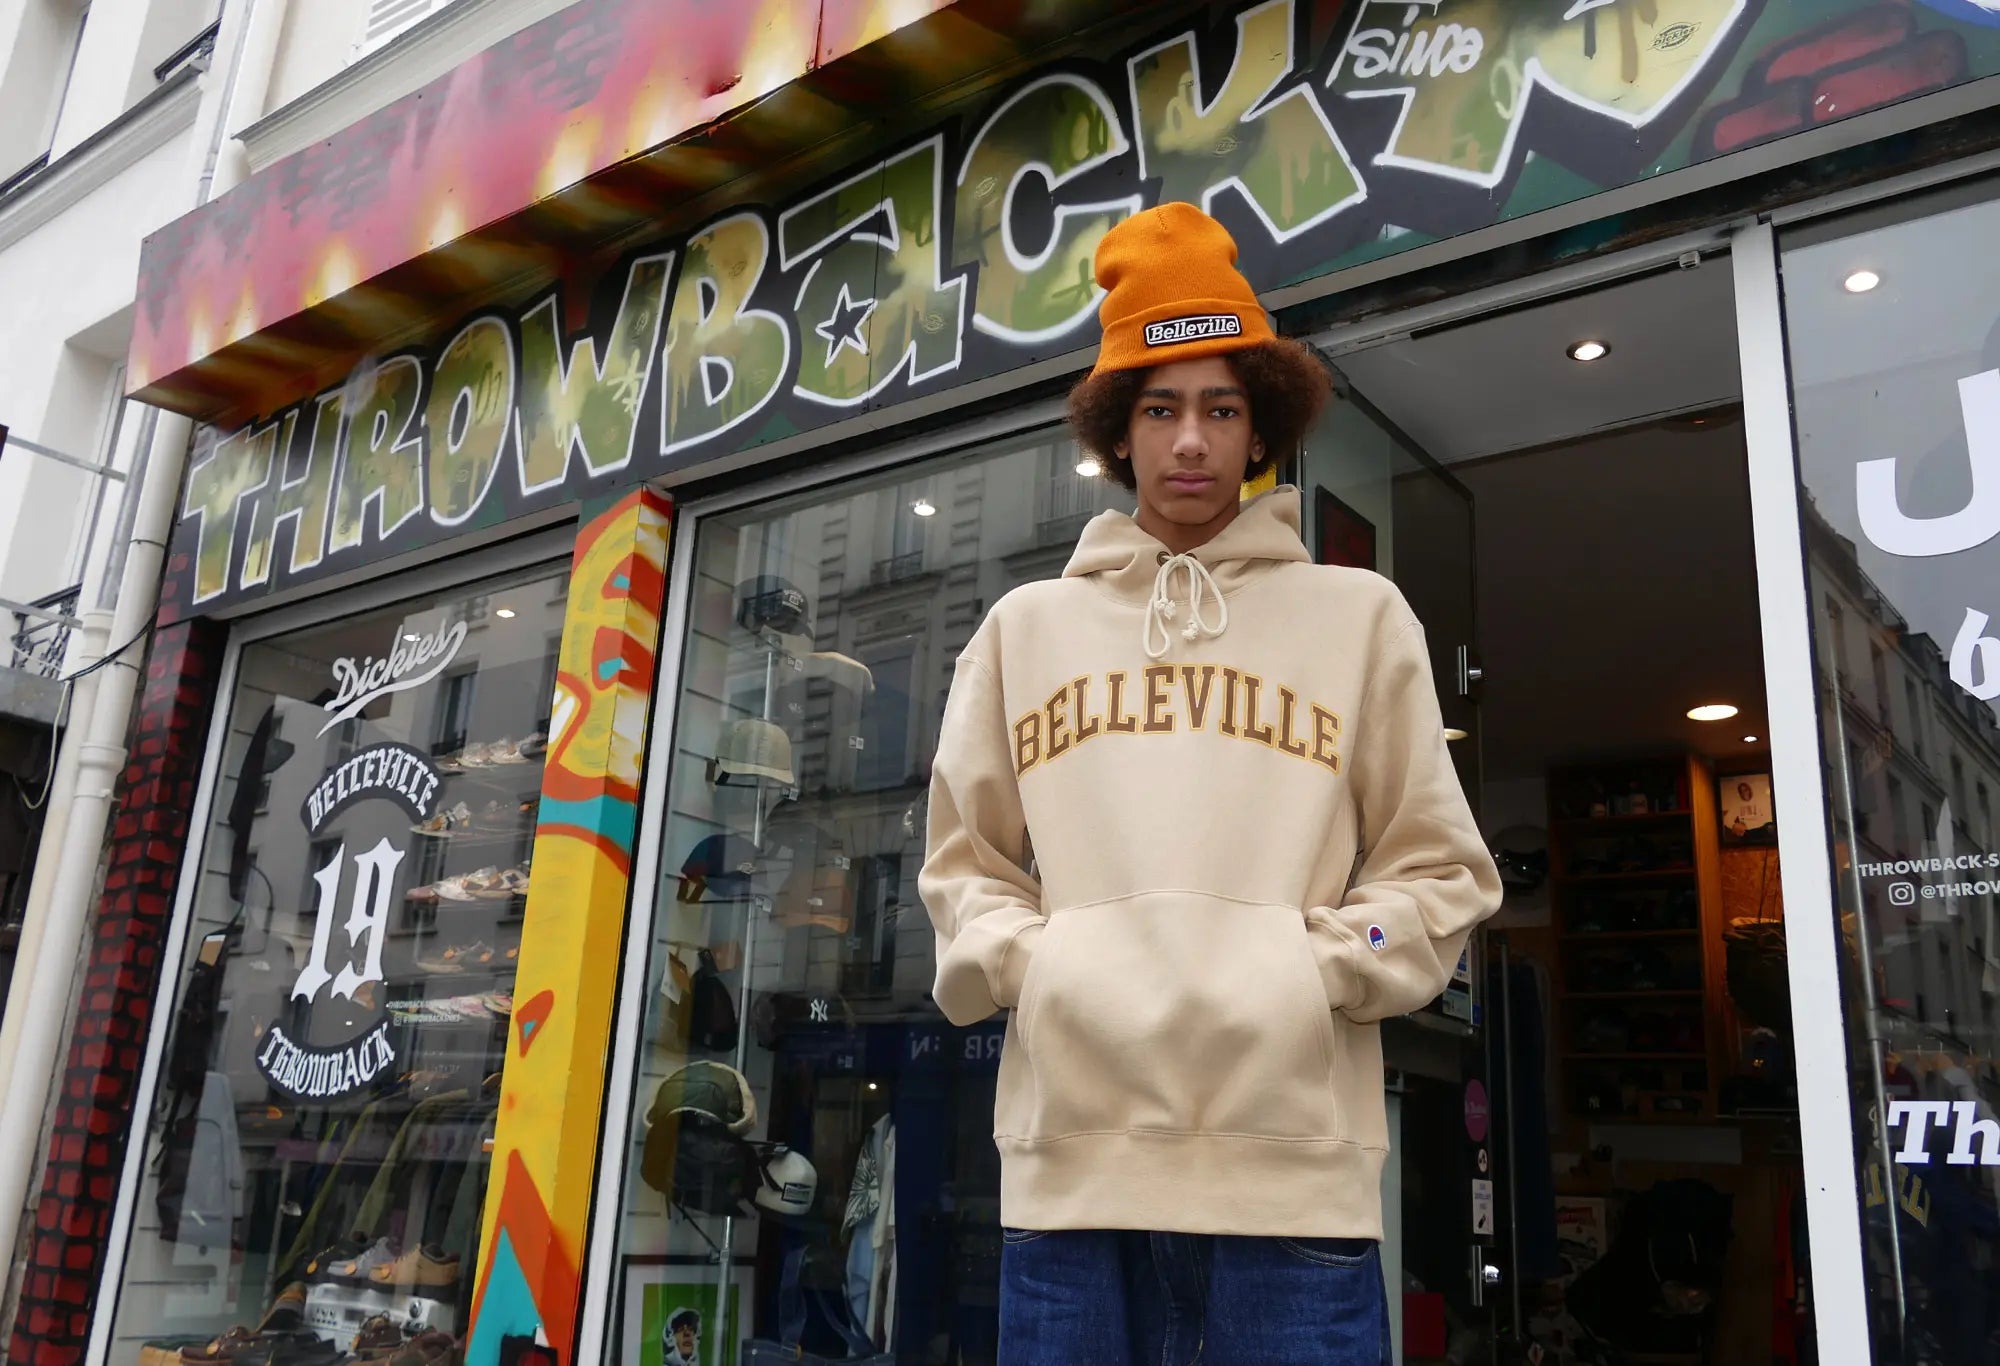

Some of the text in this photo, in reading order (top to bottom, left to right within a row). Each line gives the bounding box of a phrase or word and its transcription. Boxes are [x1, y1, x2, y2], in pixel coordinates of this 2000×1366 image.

[1149, 318, 1236, 342] Belleville
[322, 618, 467, 716] Dickies
[1013, 663, 1341, 780] BELLEVILLE
[307, 746, 440, 832] BELLEVILLE
[290, 836, 405, 1004] 19
[257, 1021, 396, 1098] THROWBACK
[1887, 1101, 2000, 1165] Th
